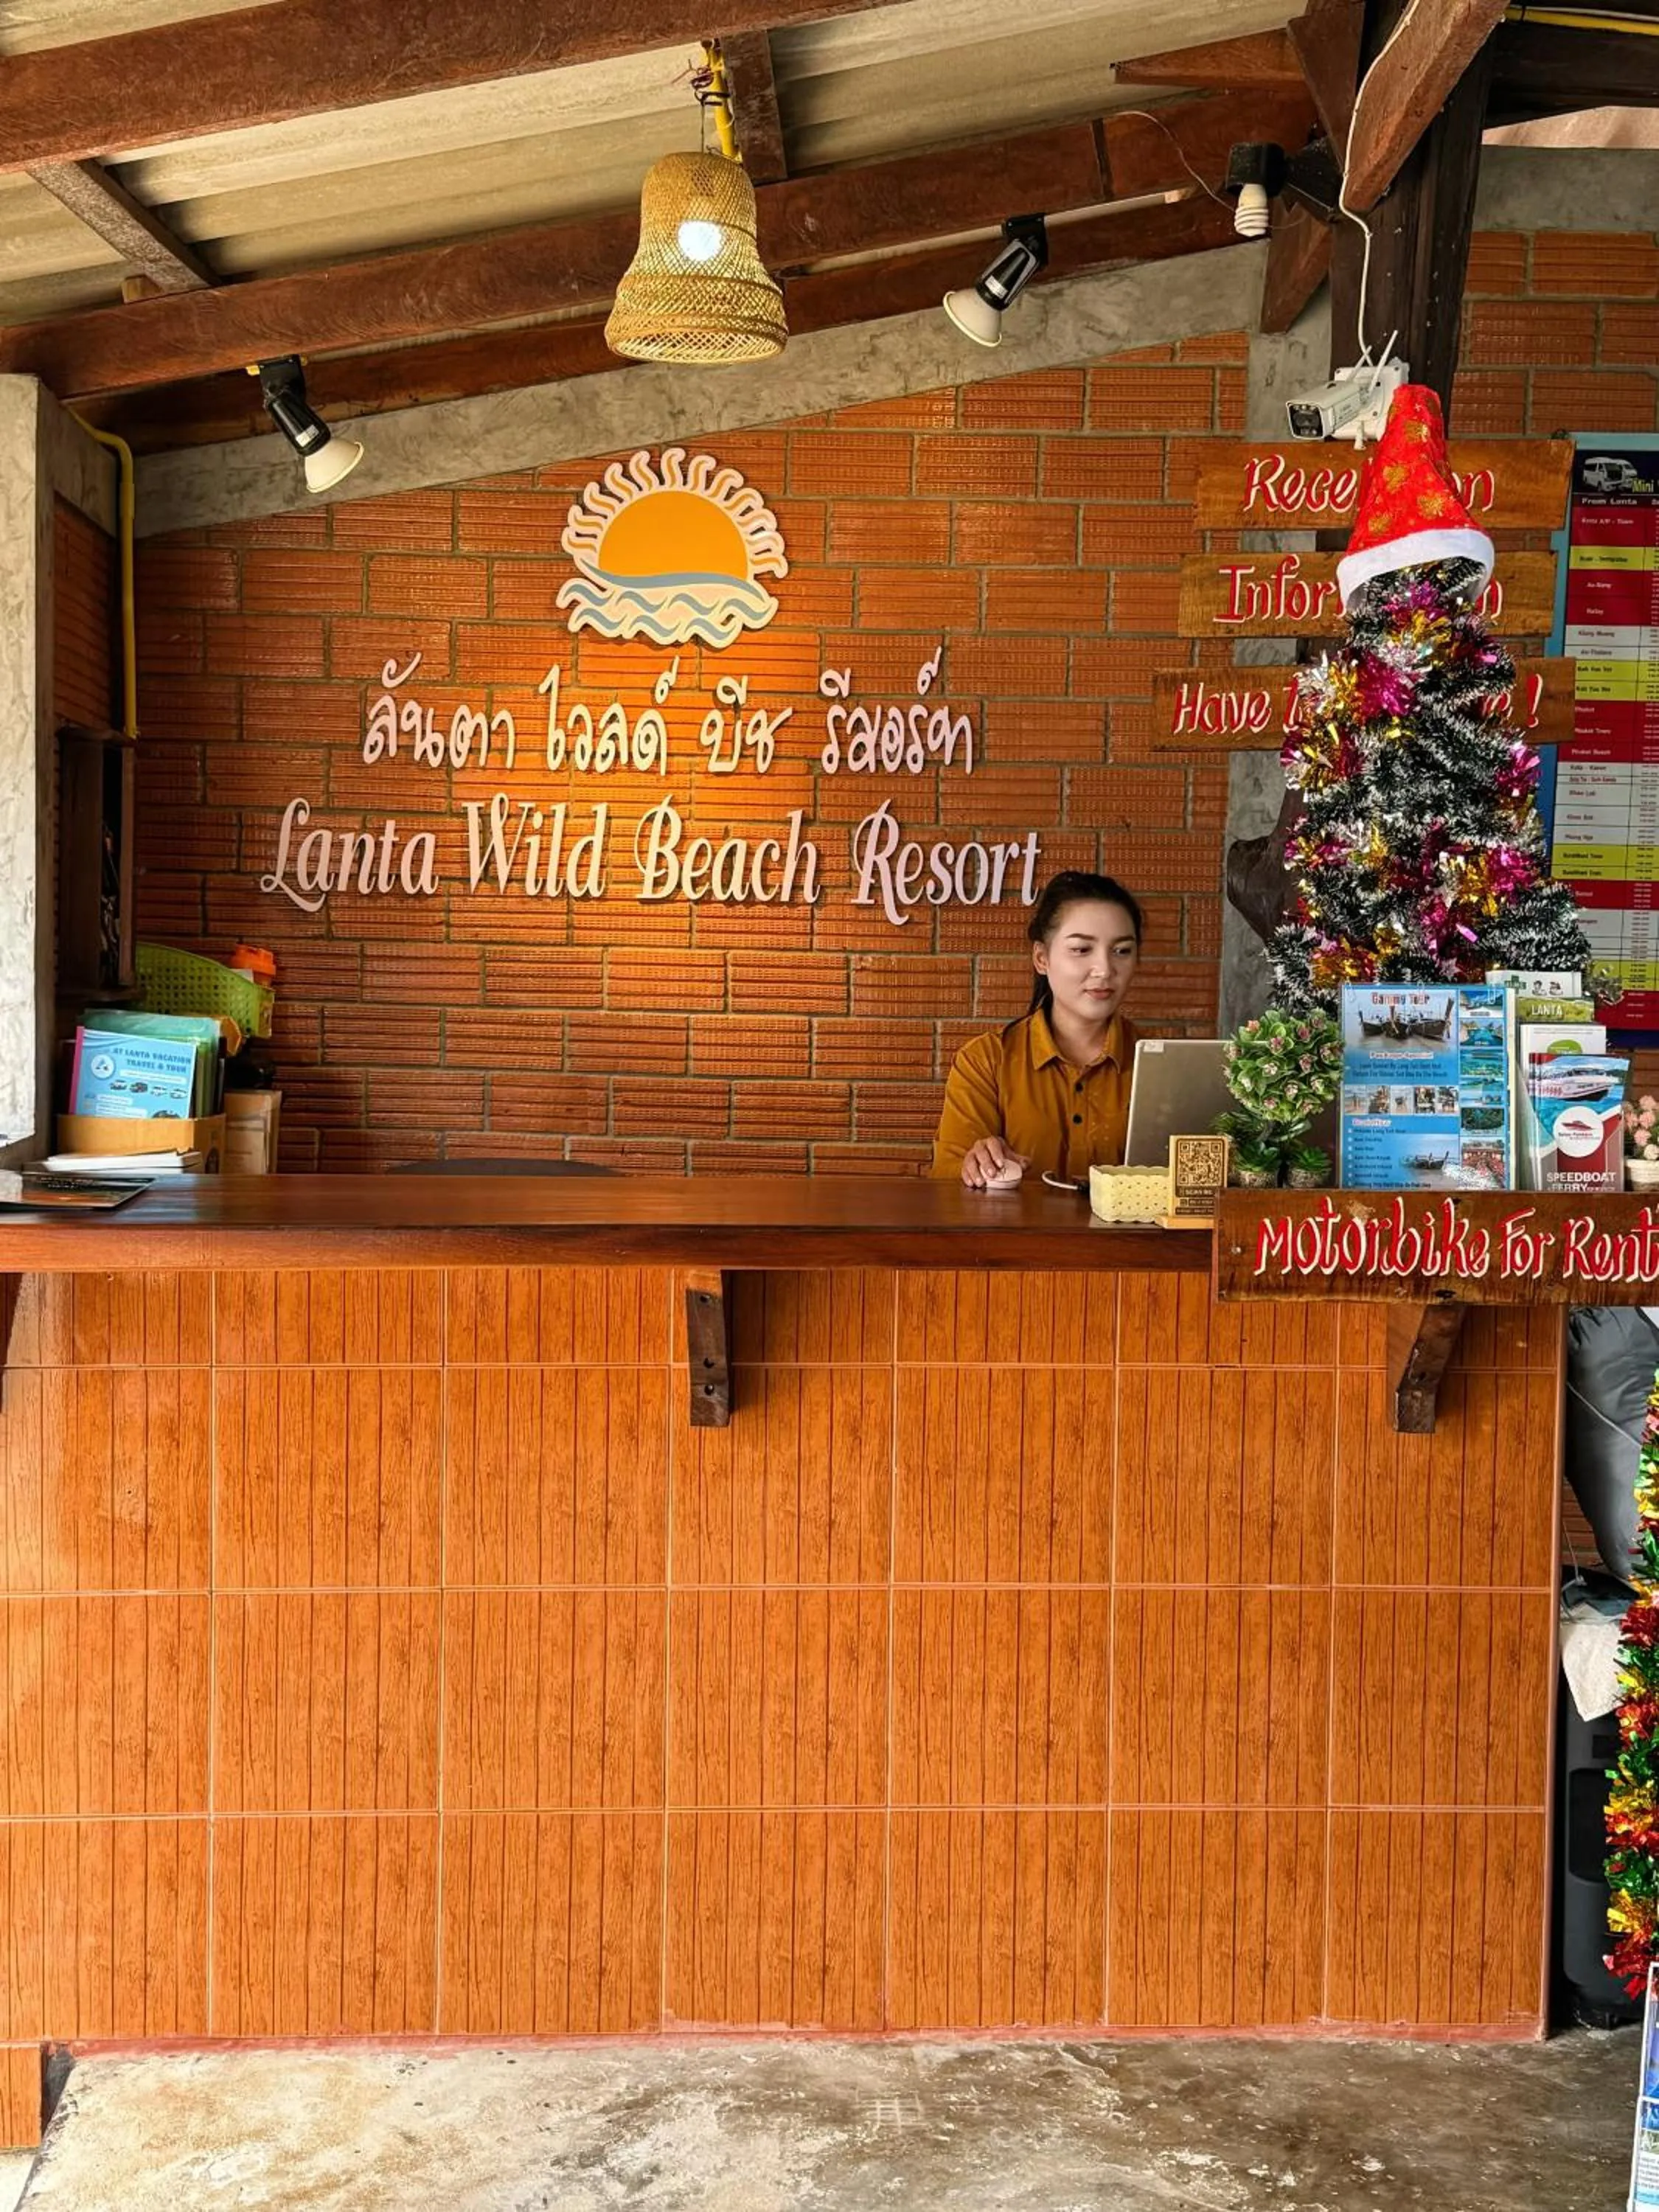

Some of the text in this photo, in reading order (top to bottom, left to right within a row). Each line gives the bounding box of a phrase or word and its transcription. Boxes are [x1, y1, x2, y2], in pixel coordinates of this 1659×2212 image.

[363, 645, 973, 777] ลันตา ไวลด์ บีช รีสอร์ท
[1171, 682, 1271, 736] Have
[260, 793, 1042, 925] Lanta Wild Beach Resort
[1531, 1004, 1563, 1016] LANTA
[1547, 1172, 1617, 1183] SPEEDBOAT
[1254, 1196, 1489, 1277] Motorbike
[1562, 1207, 1659, 1283] Rent
